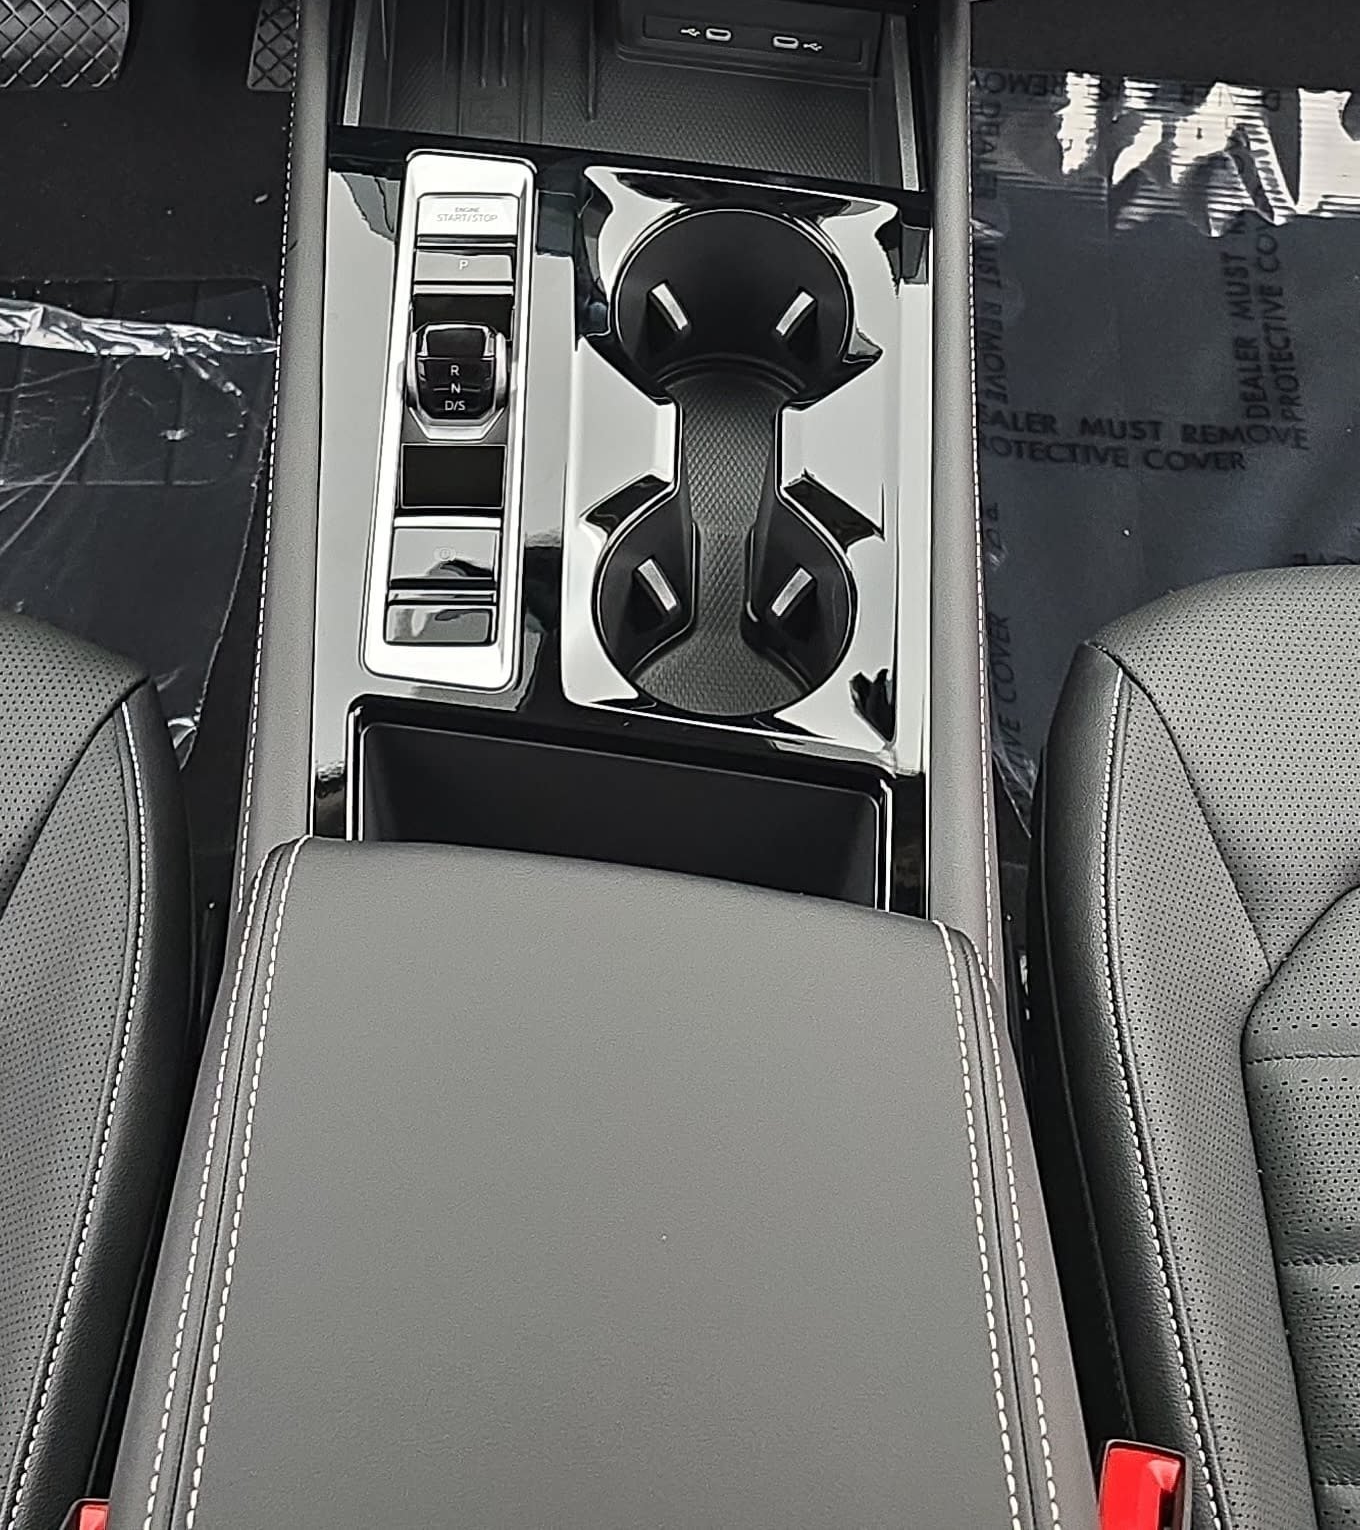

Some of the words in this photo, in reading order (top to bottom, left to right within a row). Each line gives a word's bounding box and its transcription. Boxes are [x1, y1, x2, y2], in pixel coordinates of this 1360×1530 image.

[437, 213, 498, 222] START/STOP
[459, 260, 469, 270] P
[1221, 251, 1255, 321] MUST
[1257, 285, 1306, 421] PROTECTIVE
[451, 365, 460, 377] R
[1233, 336, 1270, 420] DEALER
[451, 383, 461, 393] N
[444, 400, 466, 411] D/S
[1079, 416, 1165, 442] MUST
[1181, 422, 1309, 451] REMOVE
[1143, 448, 1247, 471] COVER
